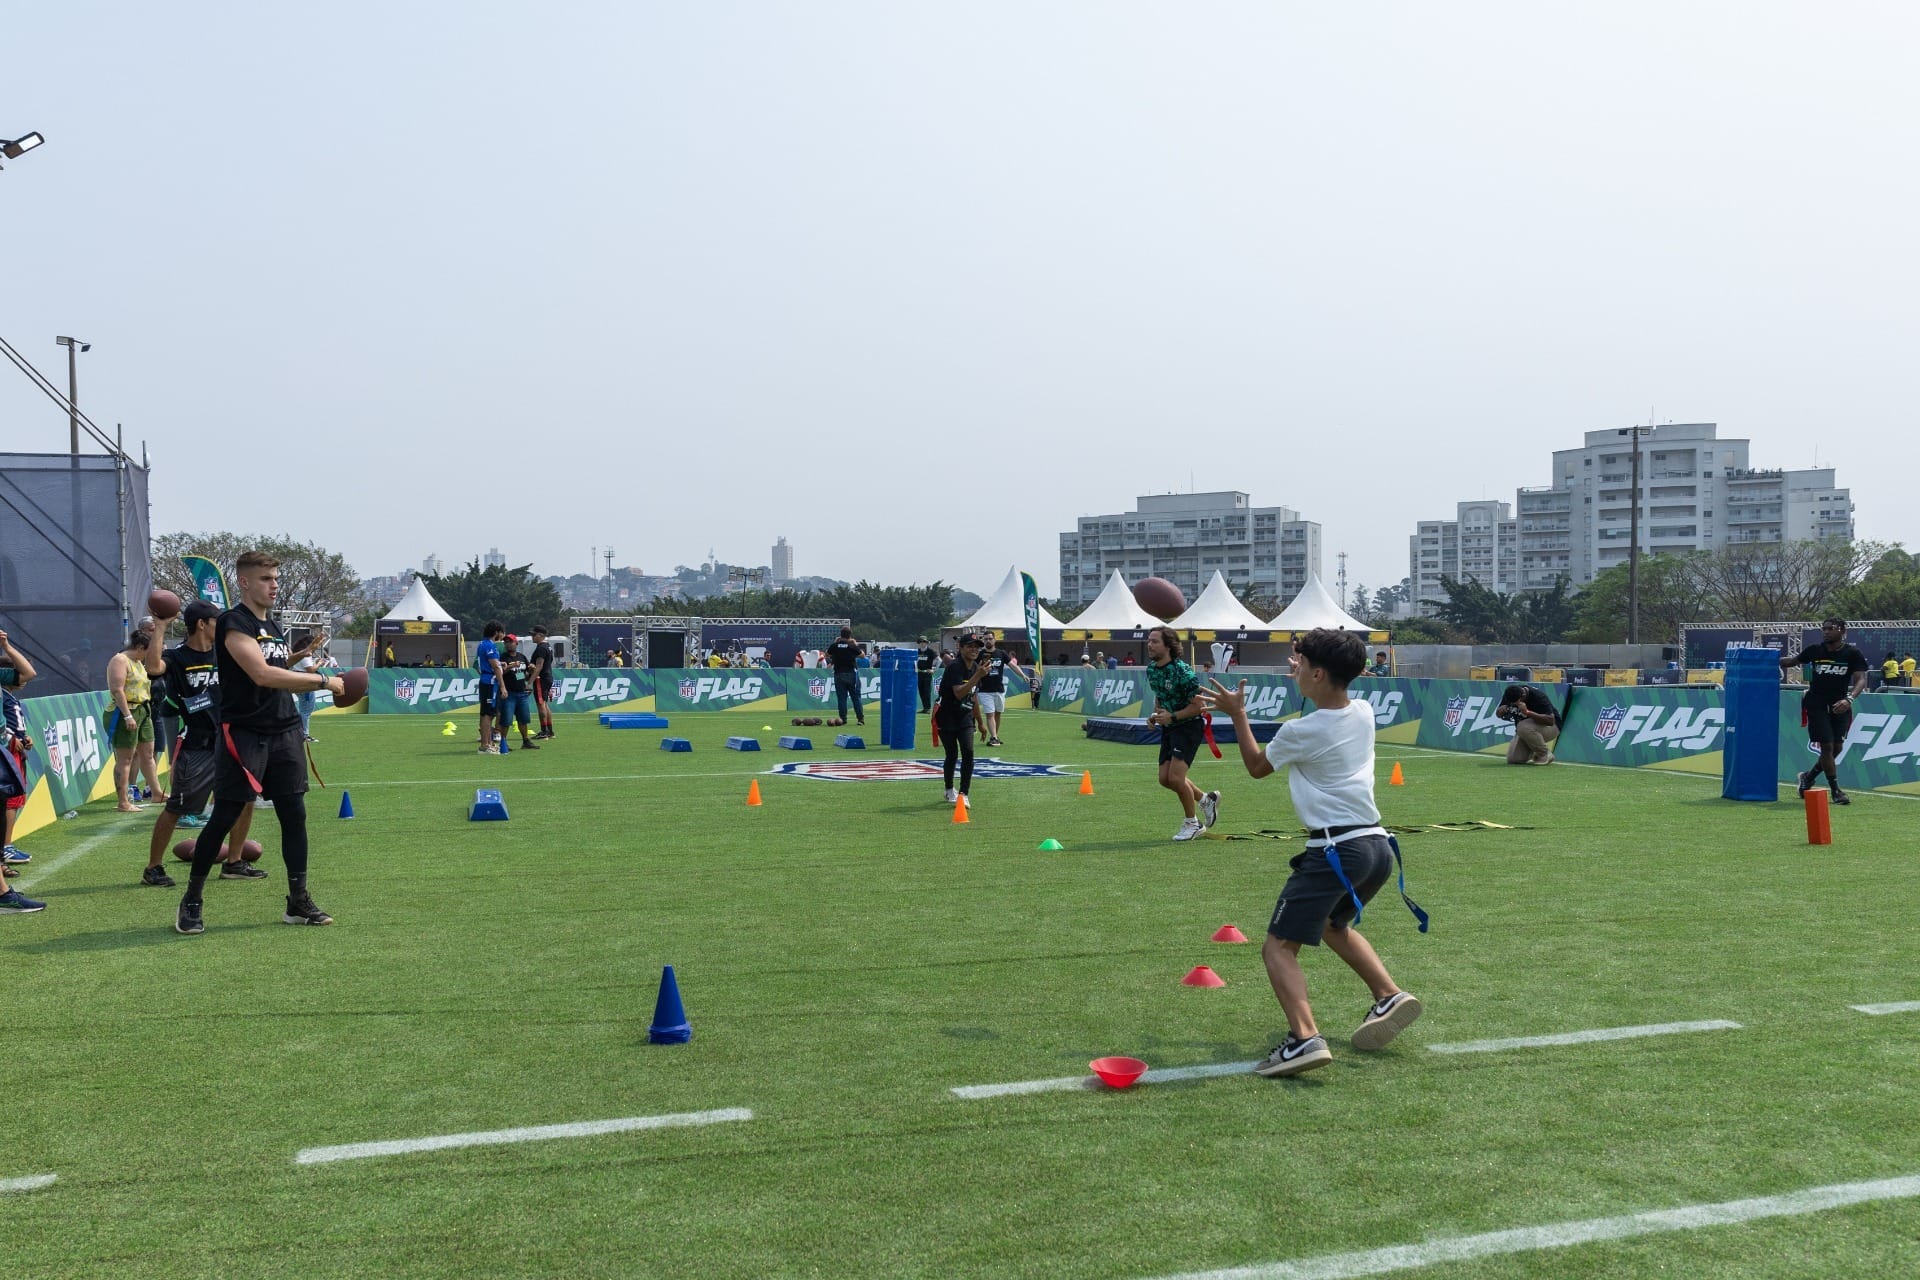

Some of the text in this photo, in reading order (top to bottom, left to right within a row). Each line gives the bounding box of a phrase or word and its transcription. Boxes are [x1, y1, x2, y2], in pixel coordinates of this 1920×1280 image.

[397, 687, 413, 697] NFL
[557, 677, 631, 704] FLAG
[681, 677, 762, 704] NFL FLAG
[811, 686, 824, 697] NFL
[1051, 677, 1081, 702] FLAG
[1097, 679, 1134, 706] FLAG
[1446, 695, 1515, 737] NFL FL
[1597, 705, 1725, 750] NFL FLAG
[56, 715, 100, 789] FLAG
